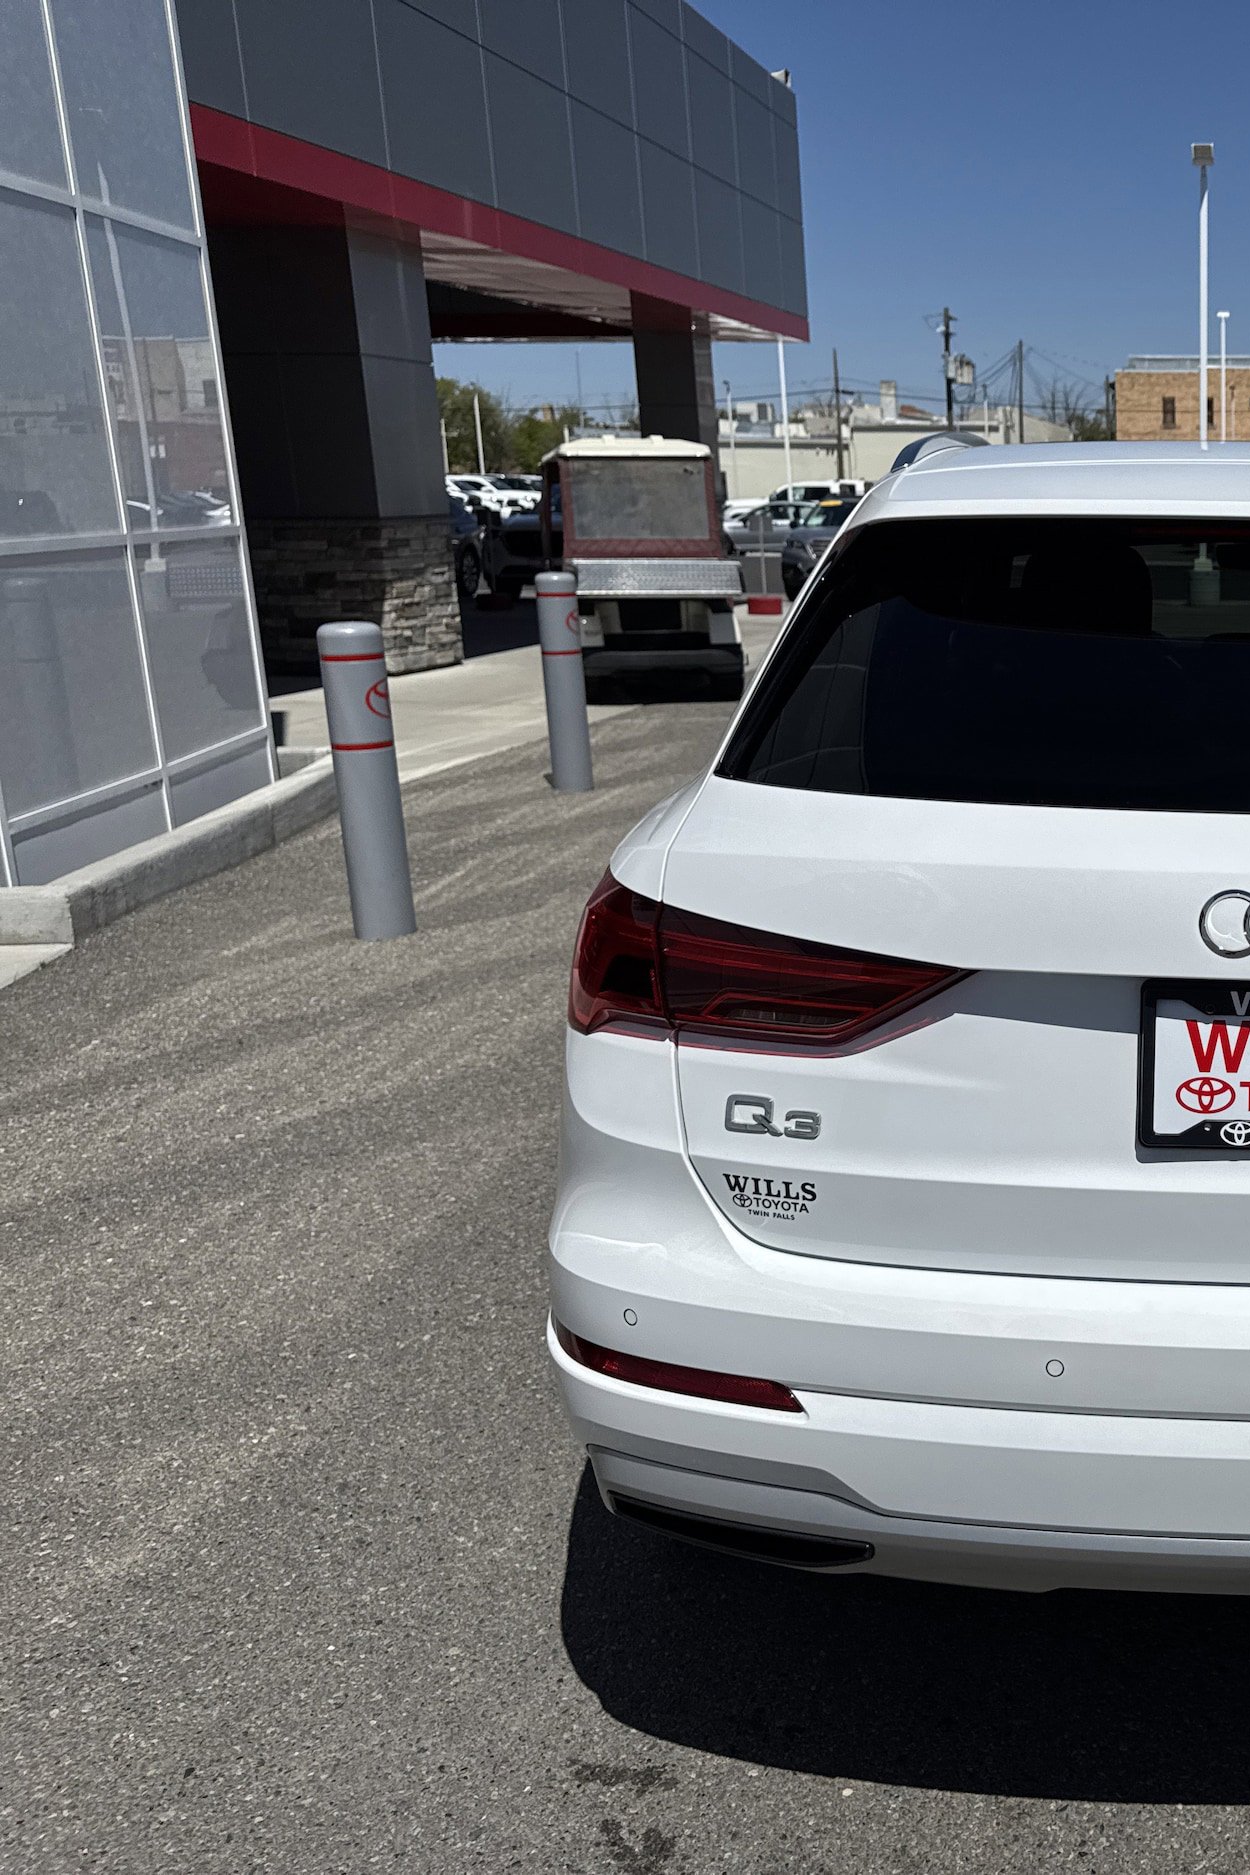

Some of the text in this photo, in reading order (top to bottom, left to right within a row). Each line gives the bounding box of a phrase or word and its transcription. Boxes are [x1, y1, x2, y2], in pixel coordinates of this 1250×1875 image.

[724, 1094, 821, 1140] Q3
[723, 1173, 817, 1201] WILLS
[748, 1209, 795, 1220] TWIN FALLS
[753, 1197, 809, 1213] TOYOTA
